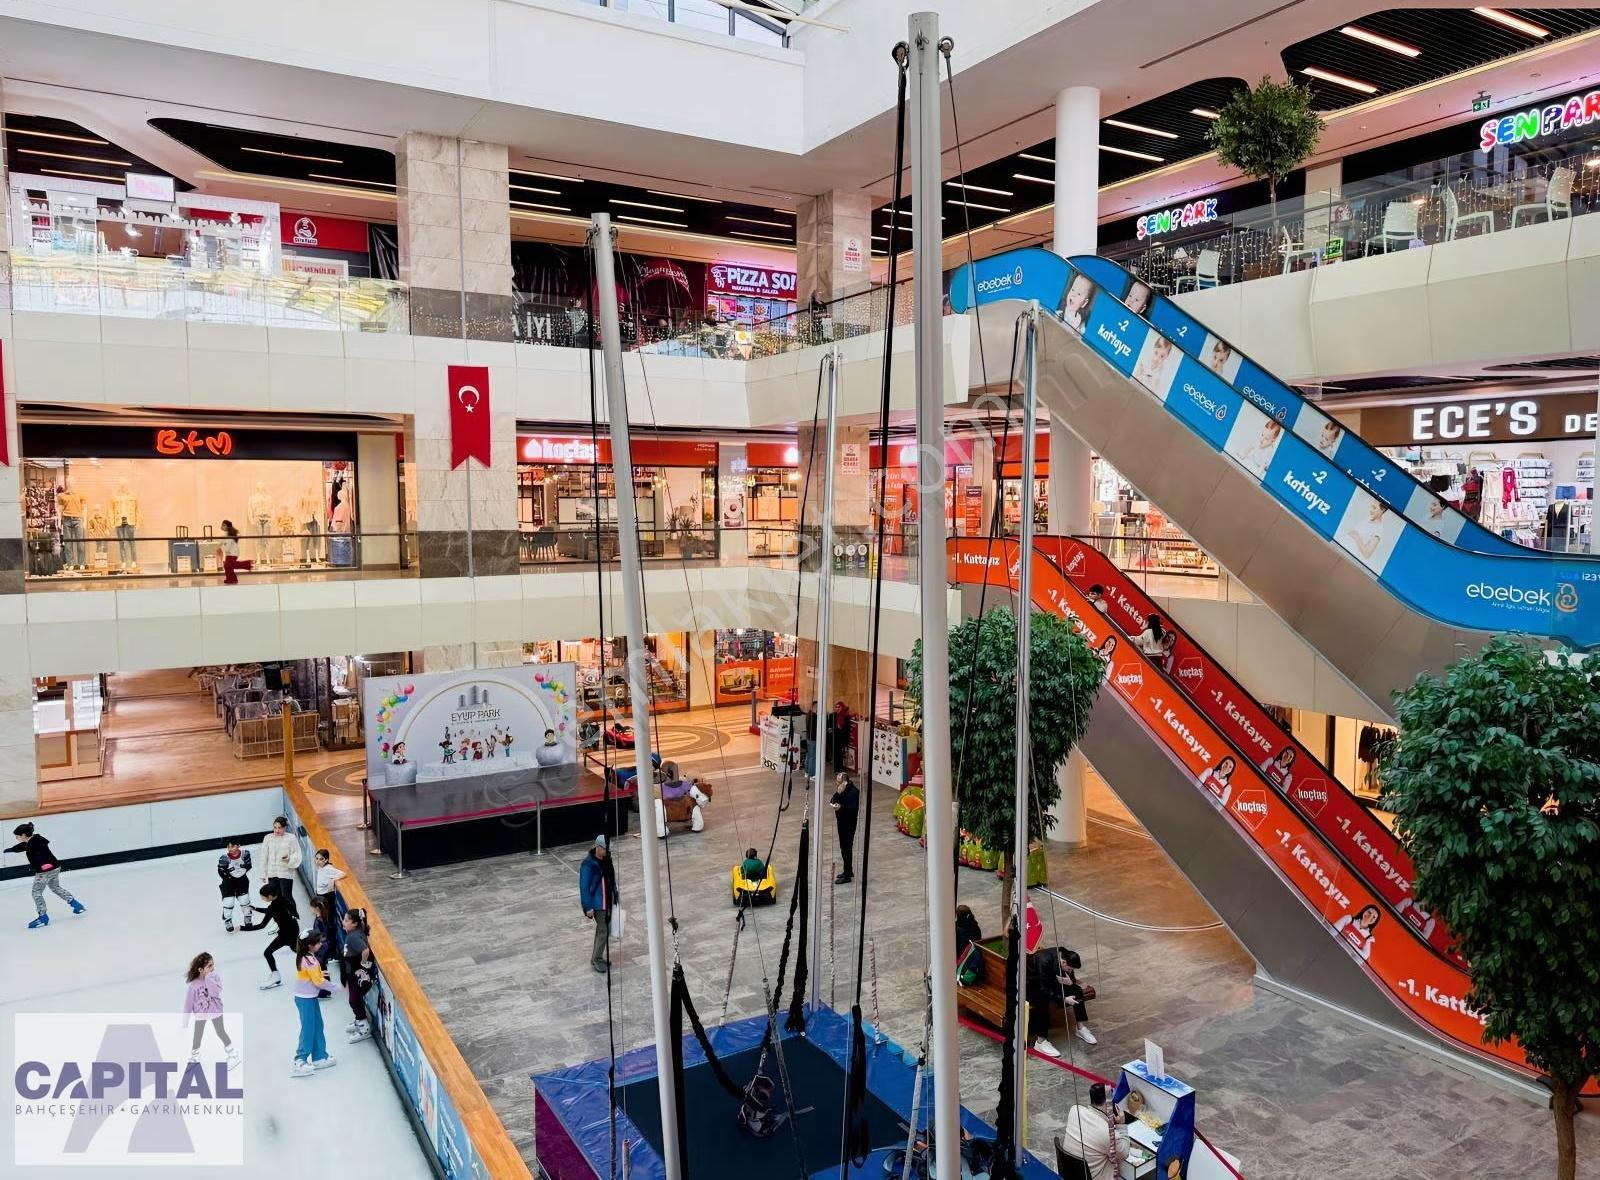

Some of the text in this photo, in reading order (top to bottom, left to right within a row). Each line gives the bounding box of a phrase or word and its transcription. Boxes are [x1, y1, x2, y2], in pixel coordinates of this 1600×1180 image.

[771, 272, 797, 291] SO!
[977, 272, 1012, 292] ebebek
[1118, 320, 1130, 332] -2
[1176, 326, 1188, 338] -2
[1097, 323, 1132, 357] kattayız
[1183, 383, 1217, 413] ebebek
[1242, 386, 1277, 414] ebebek
[1312, 470, 1328, 485] -2
[1371, 468, 1387, 482] -2
[1283, 470, 1331, 515] kattayız
[963, 552, 1000, 568] Kattayız
[1466, 582, 1551, 607] ebebek
[1057, 597, 1098, 643] Katayız
[1150, 697, 1212, 763] -1. Kattayız
[1210, 689, 1273, 753] -1. Kattayız
[1298, 787, 1328, 802] koçtaş
[1237, 799, 1268, 815] koçtaş
[1336, 815, 1411, 893] -1. Kattayız
[1275, 829, 1351, 909] -1. Kattayız
[1398, 978, 1420, 997] -1.
